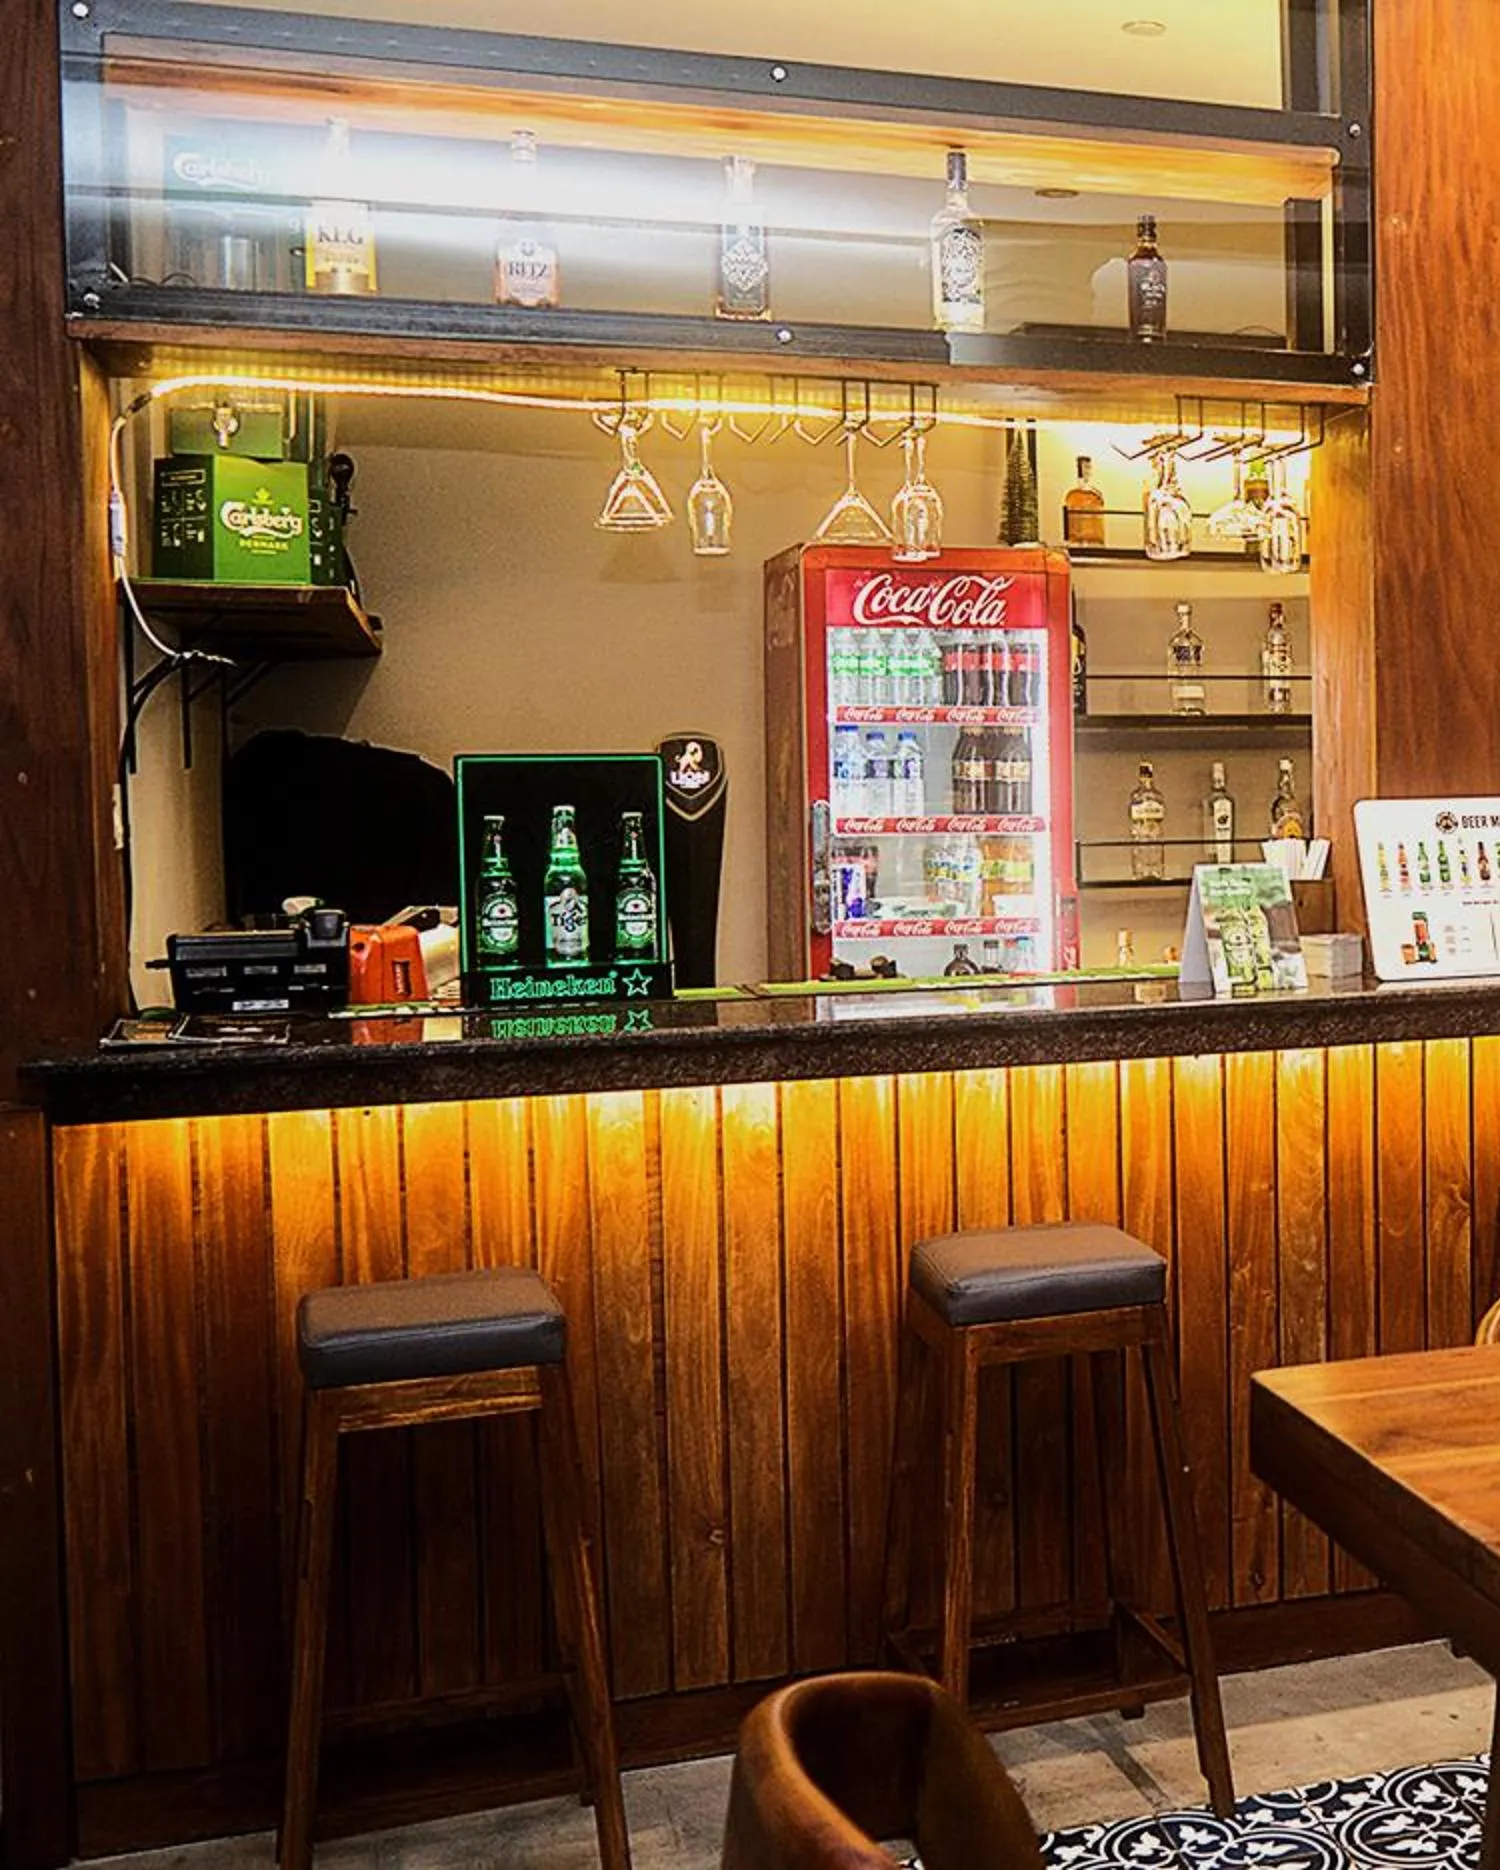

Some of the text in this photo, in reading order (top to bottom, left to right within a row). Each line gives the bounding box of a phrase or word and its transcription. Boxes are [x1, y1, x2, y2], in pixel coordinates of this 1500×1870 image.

[221, 501, 304, 539] Carlsberg
[1461, 815, 1488, 829] BEER
[489, 974, 617, 1000] Heineken
